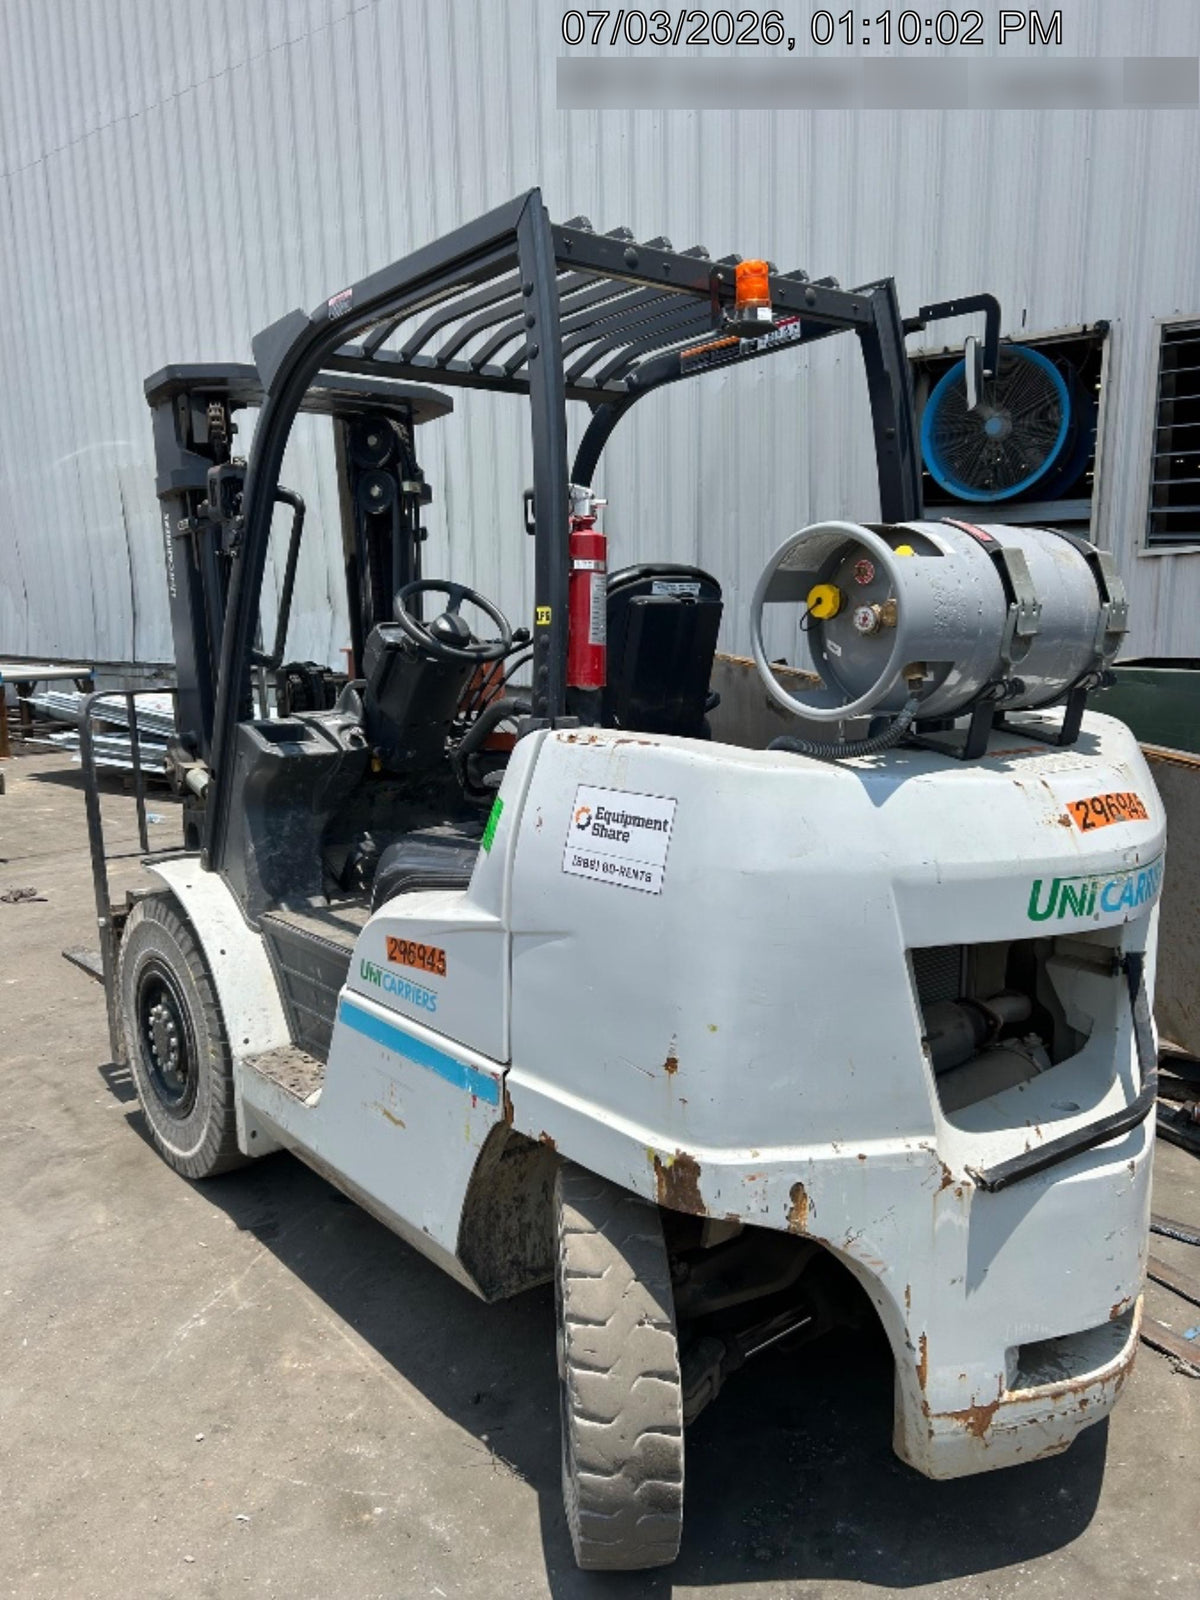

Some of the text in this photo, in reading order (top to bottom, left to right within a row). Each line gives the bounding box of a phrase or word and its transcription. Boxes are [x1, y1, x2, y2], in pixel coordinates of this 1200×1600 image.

[595, 806, 669, 832] Equipment
[591, 822, 630, 843] Share
[388, 938, 446, 974] 296945
